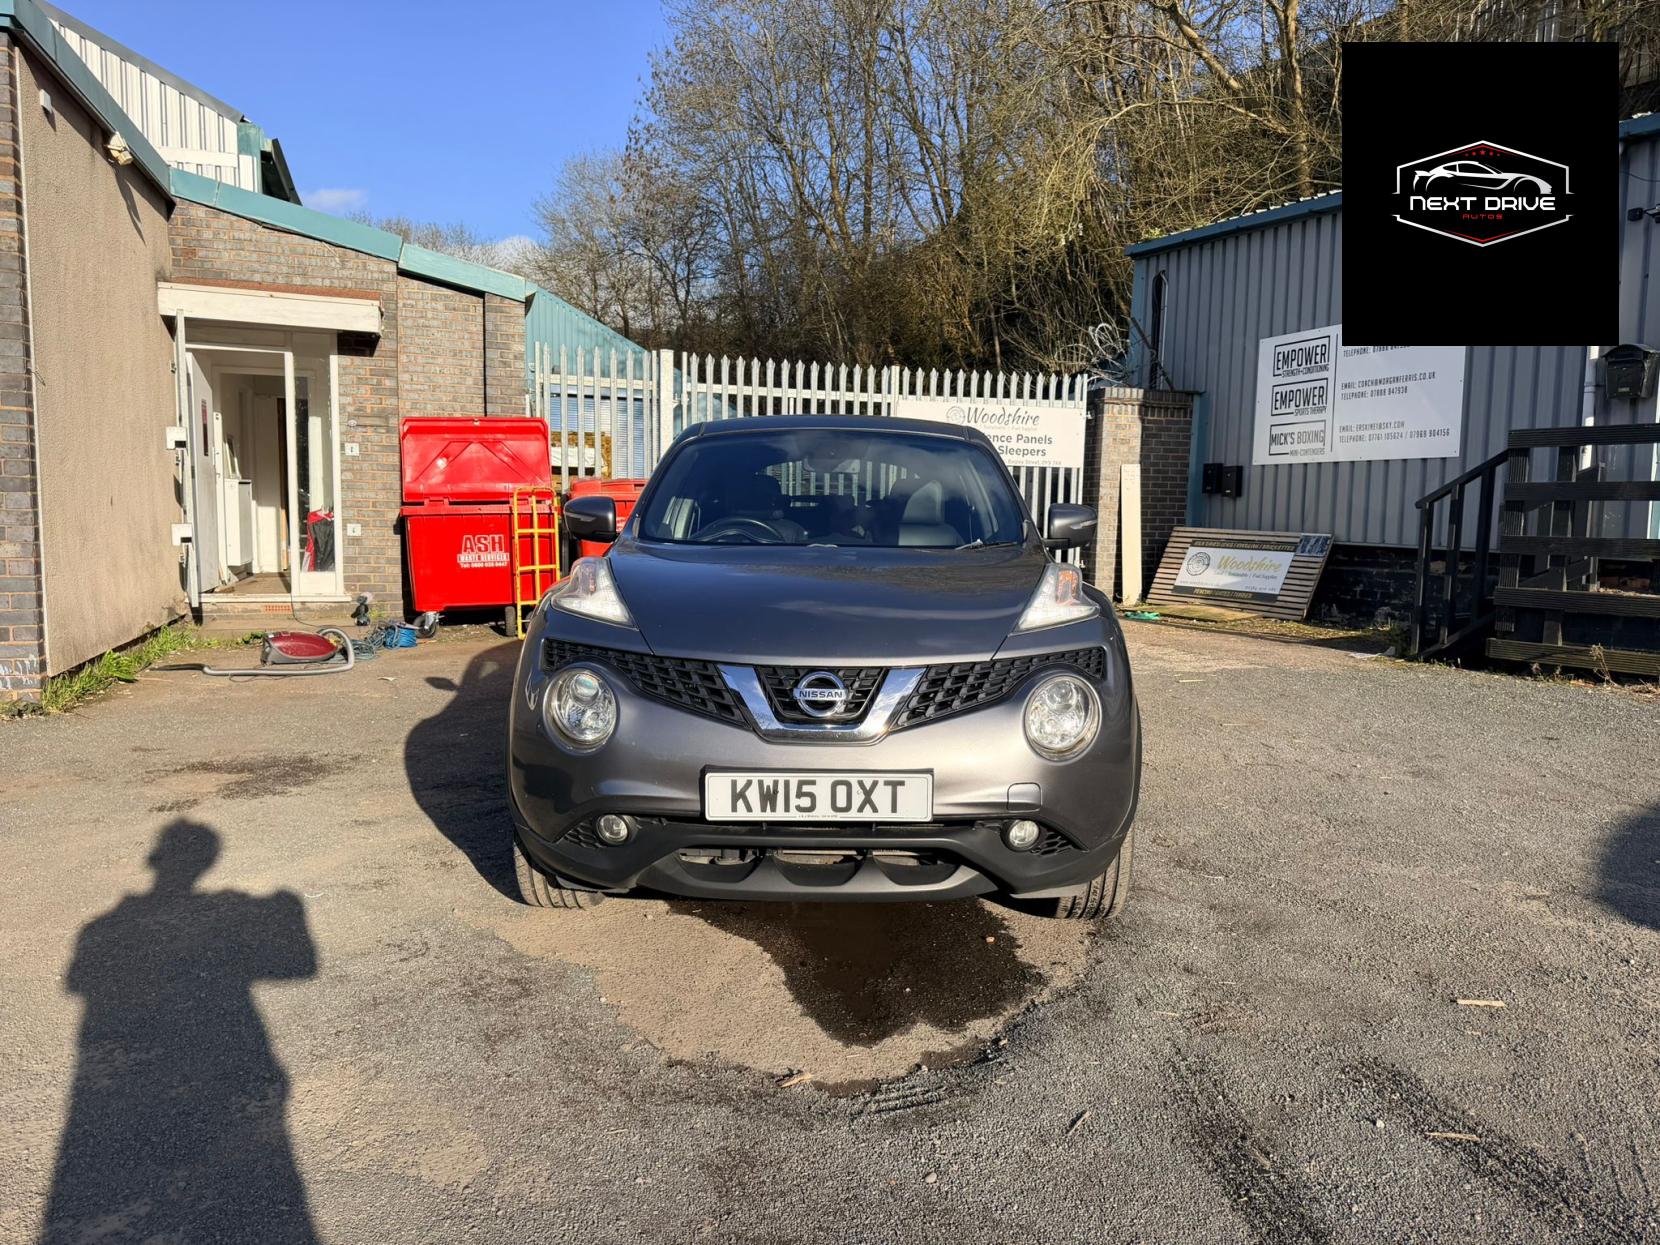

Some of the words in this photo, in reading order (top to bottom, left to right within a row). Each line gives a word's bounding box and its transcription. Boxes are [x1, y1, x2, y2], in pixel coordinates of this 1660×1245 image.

[1276, 343, 1327, 371] EMPOWER
[1274, 384, 1325, 411] EMPOWER
[1341, 390, 1369, 401] TELEPHONE:
[967, 406, 1040, 425] Woodshire
[986, 434, 1012, 443] ence
[1016, 433, 1053, 445] Panels
[1270, 431, 1295, 447] MICK'S
[1296, 429, 1324, 445] BOXING
[998, 445, 1047, 458] Sleepers
[461, 534, 505, 553] ASH
[1217, 555, 1282, 572] Woodshire
[799, 690, 843, 699] NISSAN
[730, 779, 817, 814] KW15
[830, 779, 906, 814] OXT
